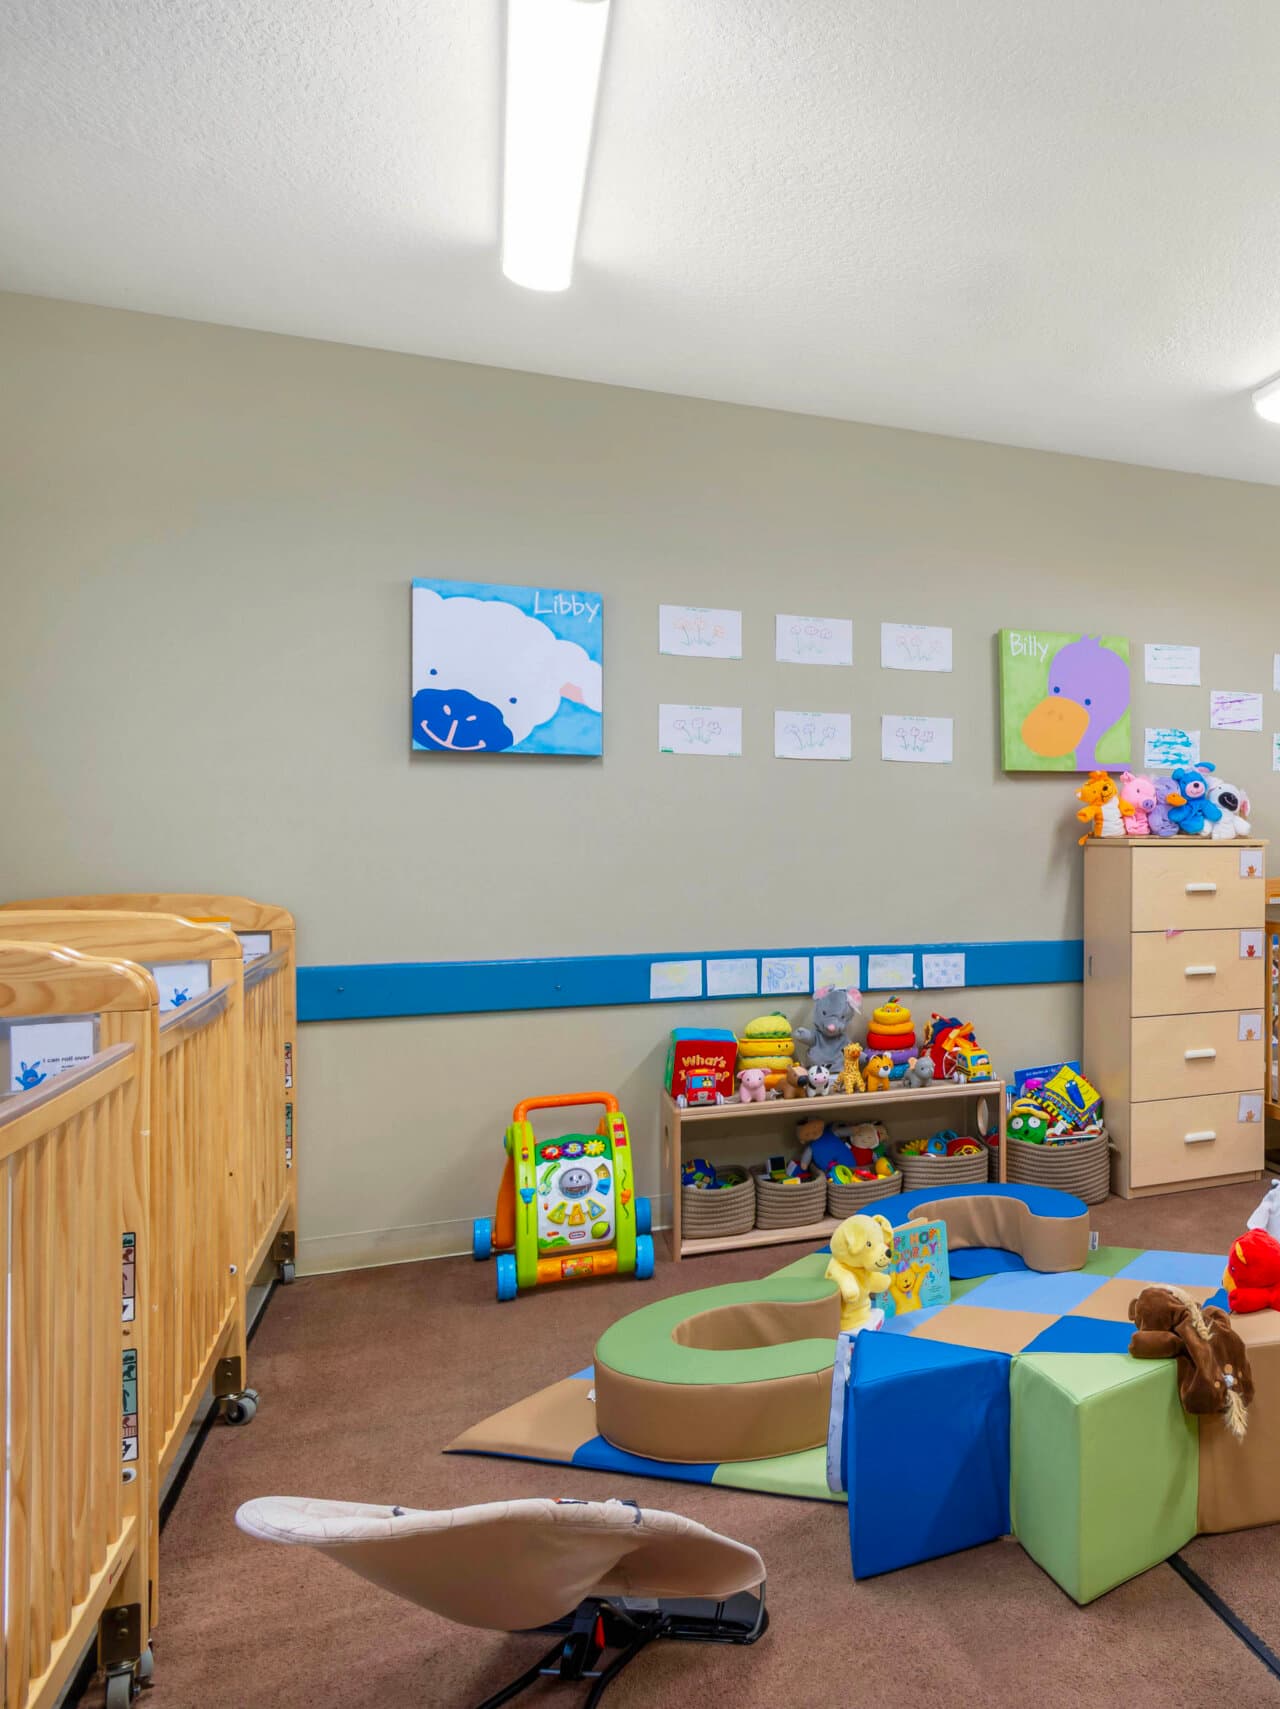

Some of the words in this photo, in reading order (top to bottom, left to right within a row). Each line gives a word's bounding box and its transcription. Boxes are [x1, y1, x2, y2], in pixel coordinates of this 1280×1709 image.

[534, 591, 600, 624] Libby
[1009, 631, 1049, 665] Billy
[681, 1054, 727, 1069] What's
